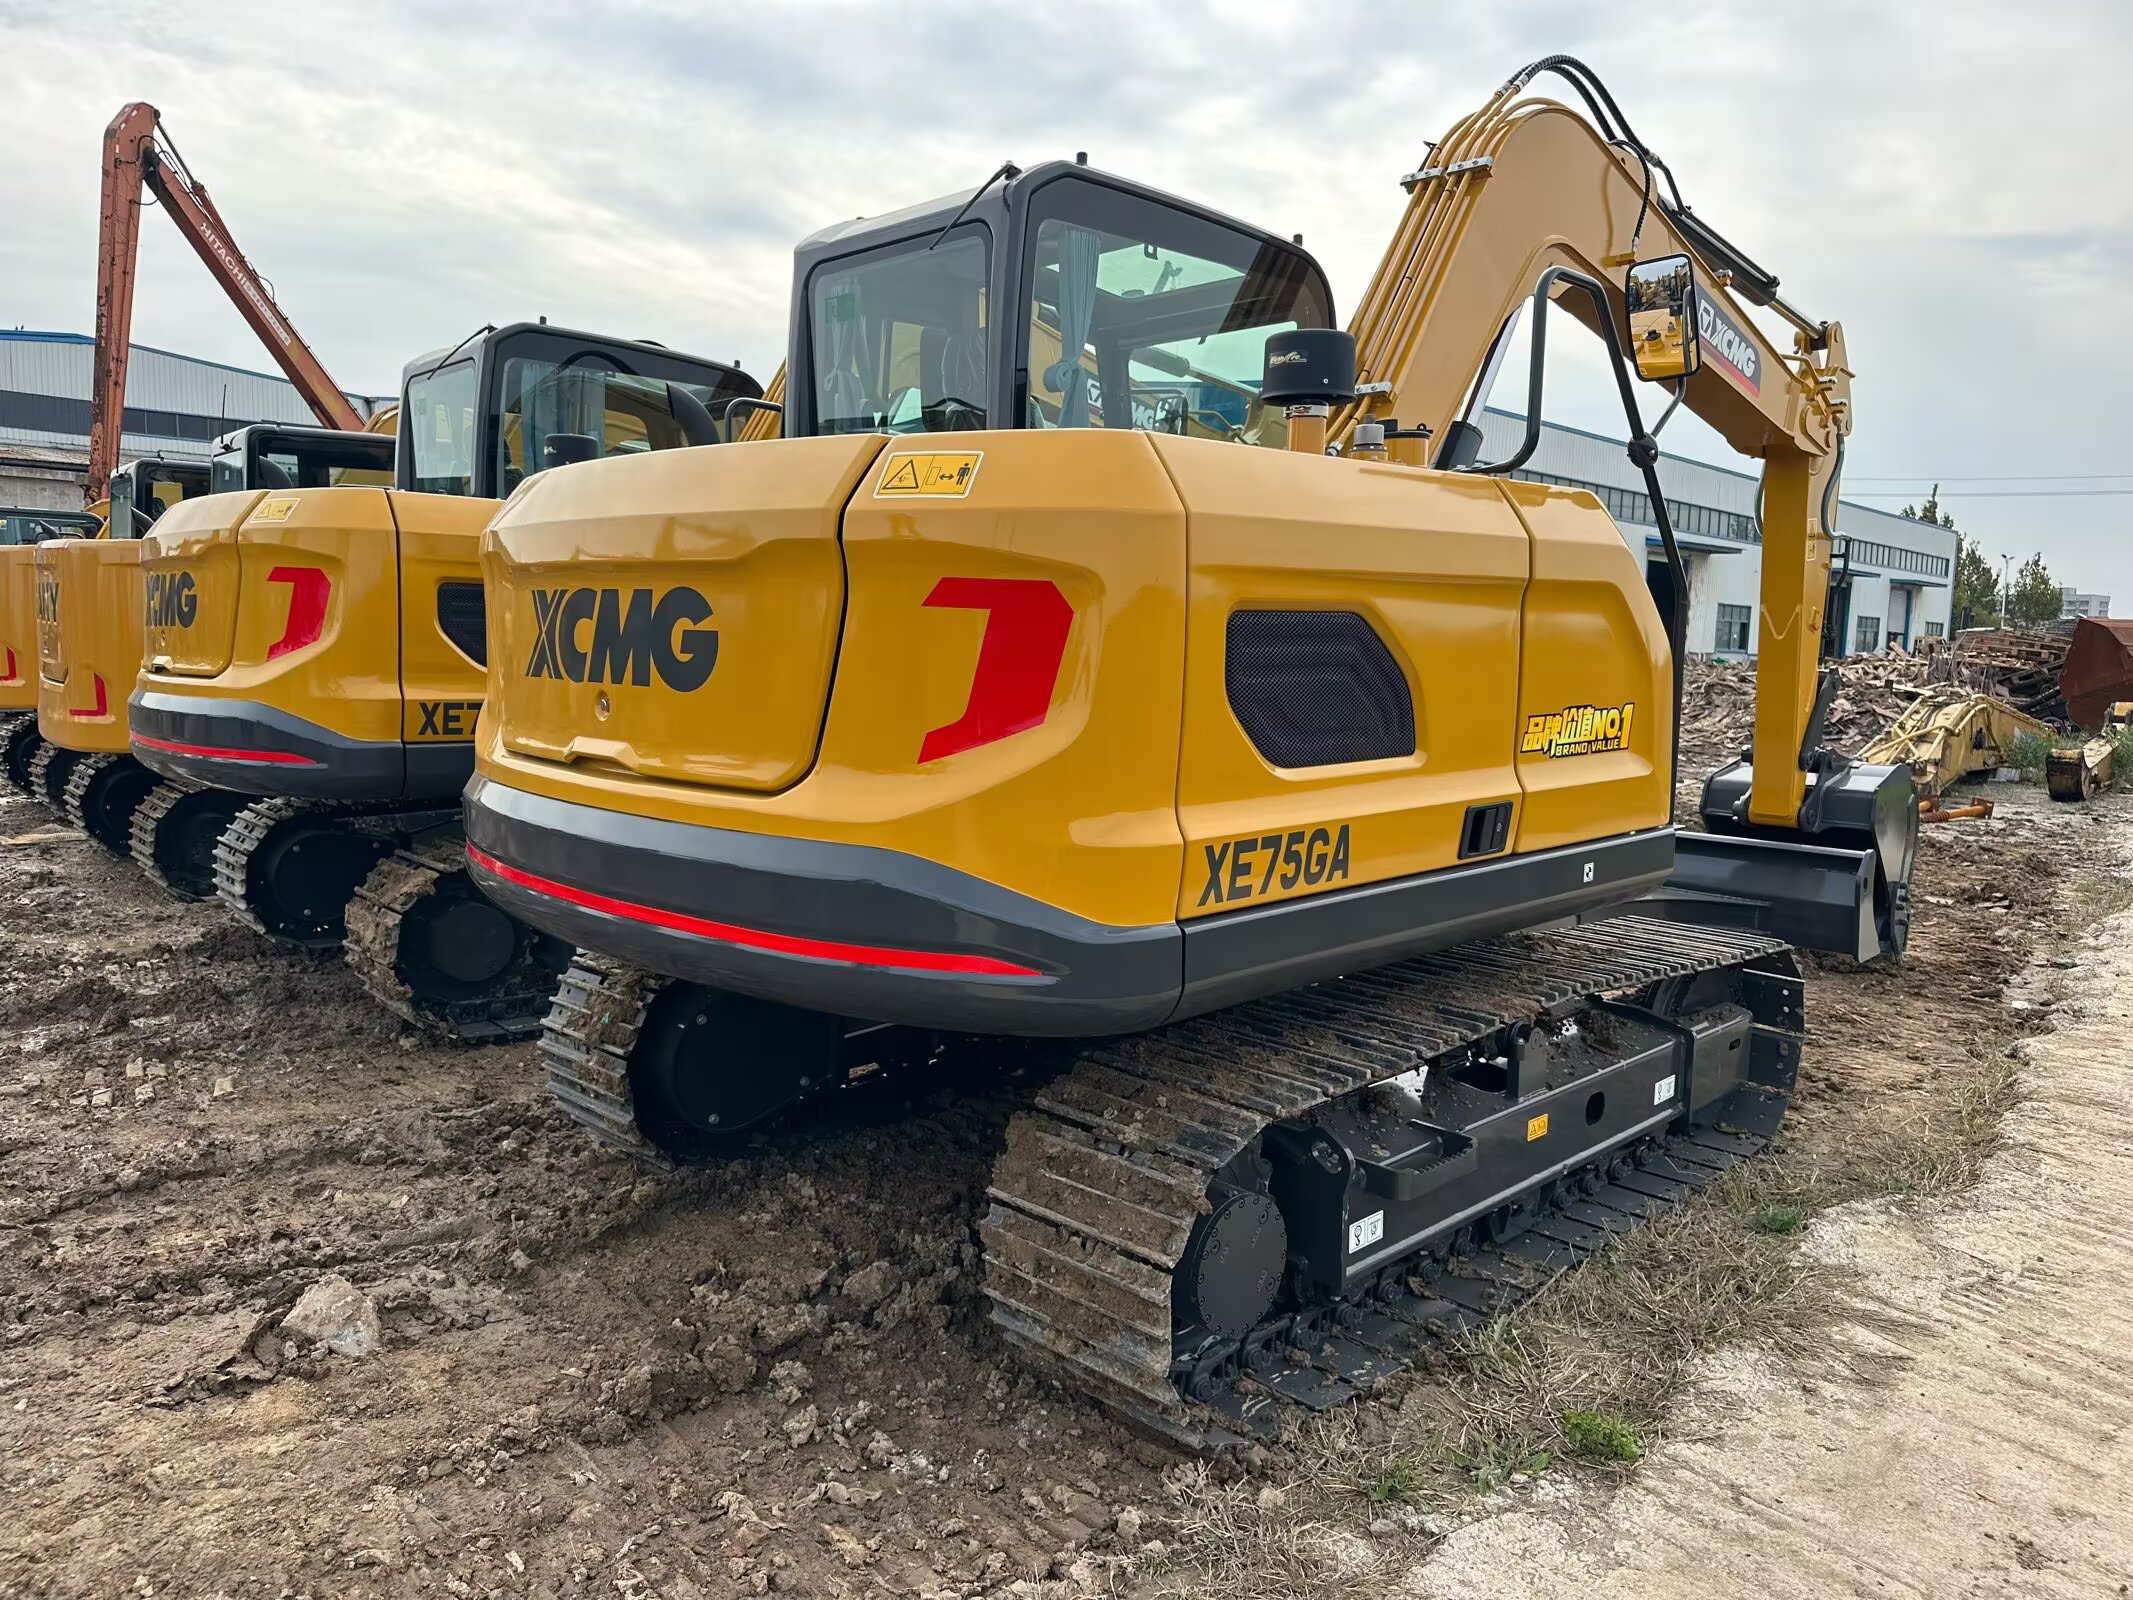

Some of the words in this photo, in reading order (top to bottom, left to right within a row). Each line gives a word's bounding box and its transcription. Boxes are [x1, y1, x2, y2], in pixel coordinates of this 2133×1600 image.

[201, 222, 247, 285] HITACHI
[1709, 316, 1756, 378] XCMG
[145, 571, 198, 629] XCMG
[525, 586, 719, 692] XCMG
[1555, 742, 1588, 756] BRAND
[1591, 738, 1620, 752] VALUE
[1196, 824, 1350, 907] XE75GA
